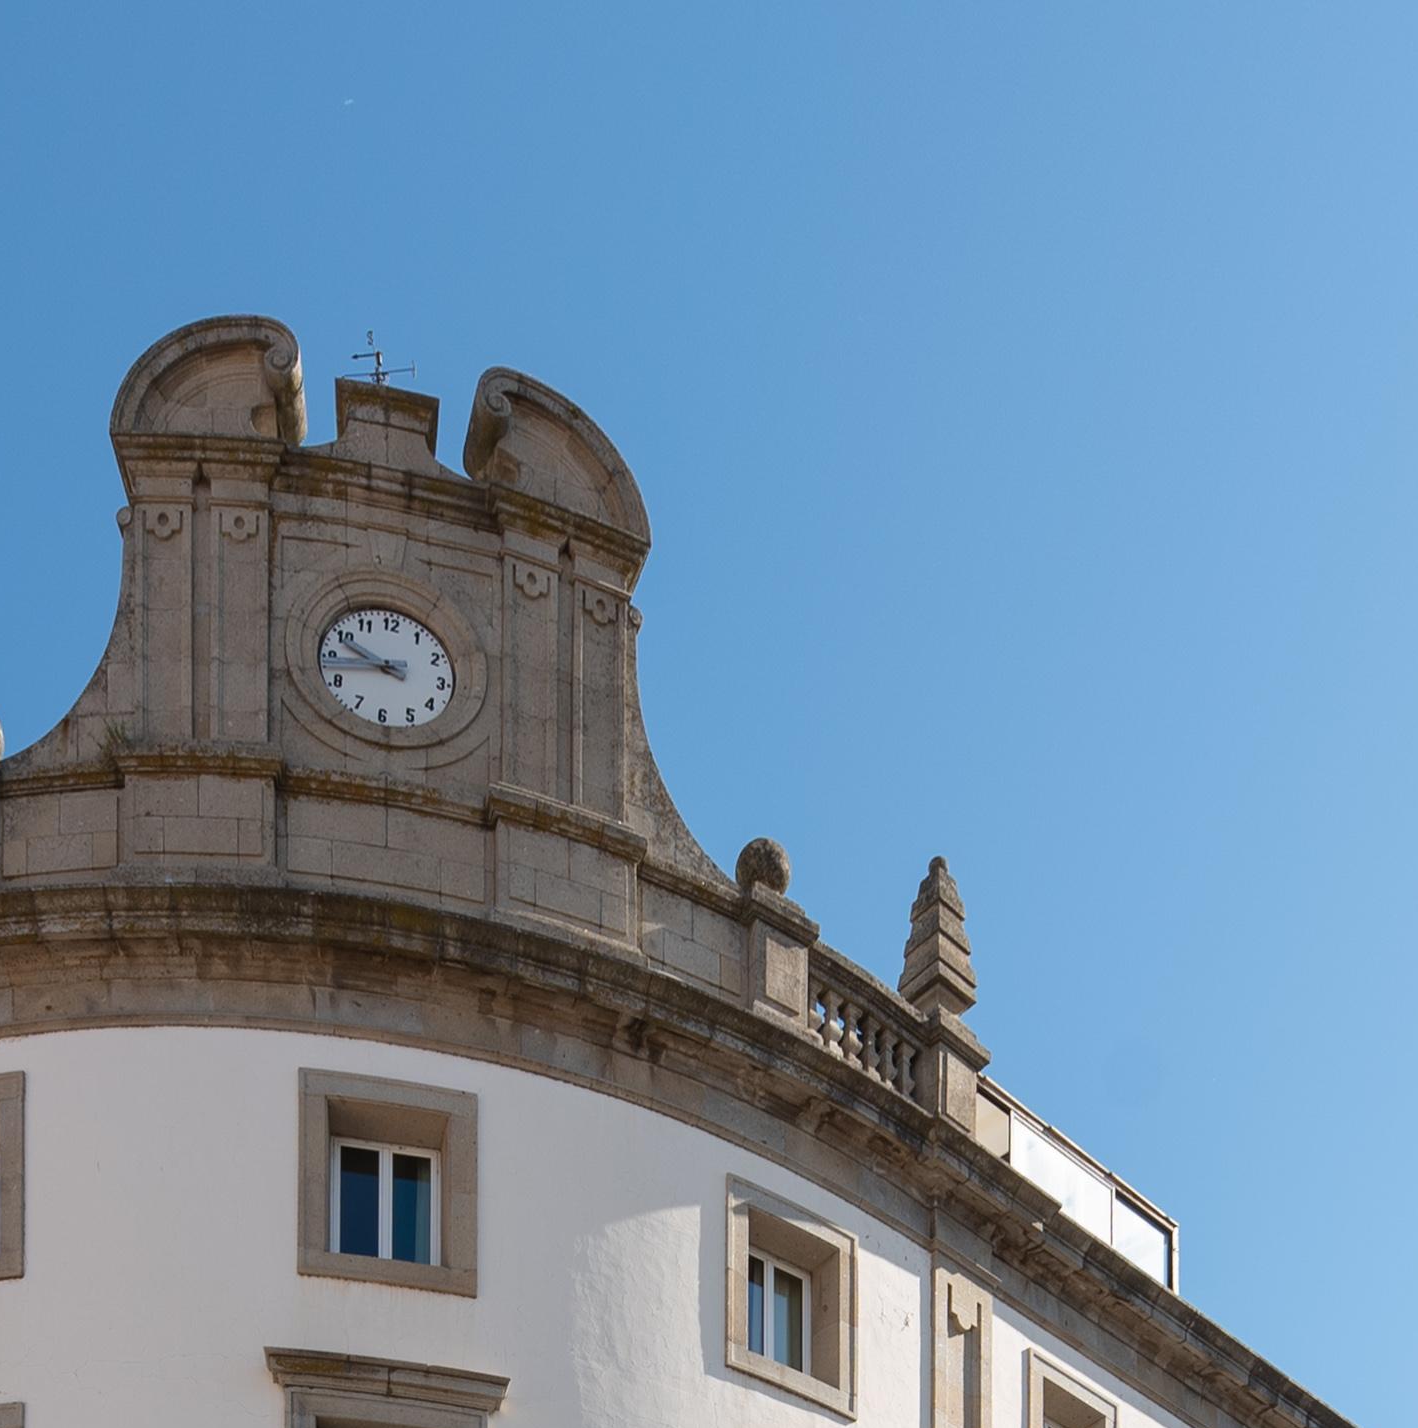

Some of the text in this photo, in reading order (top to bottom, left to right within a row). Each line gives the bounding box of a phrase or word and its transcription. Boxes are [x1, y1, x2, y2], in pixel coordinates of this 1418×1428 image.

[358, 618, 372, 633] 11
[383, 618, 400, 633] 12
[337, 630, 354, 644] 10
[414, 632, 421, 645] 1
[431, 652, 440, 666] 2
[333, 674, 343, 688] 8
[436, 677, 445, 691] 3
[354, 695, 364, 709] 7
[424, 697, 435, 711] 4
[378, 709, 387, 723] 6
[405, 708, 415, 722] 5
